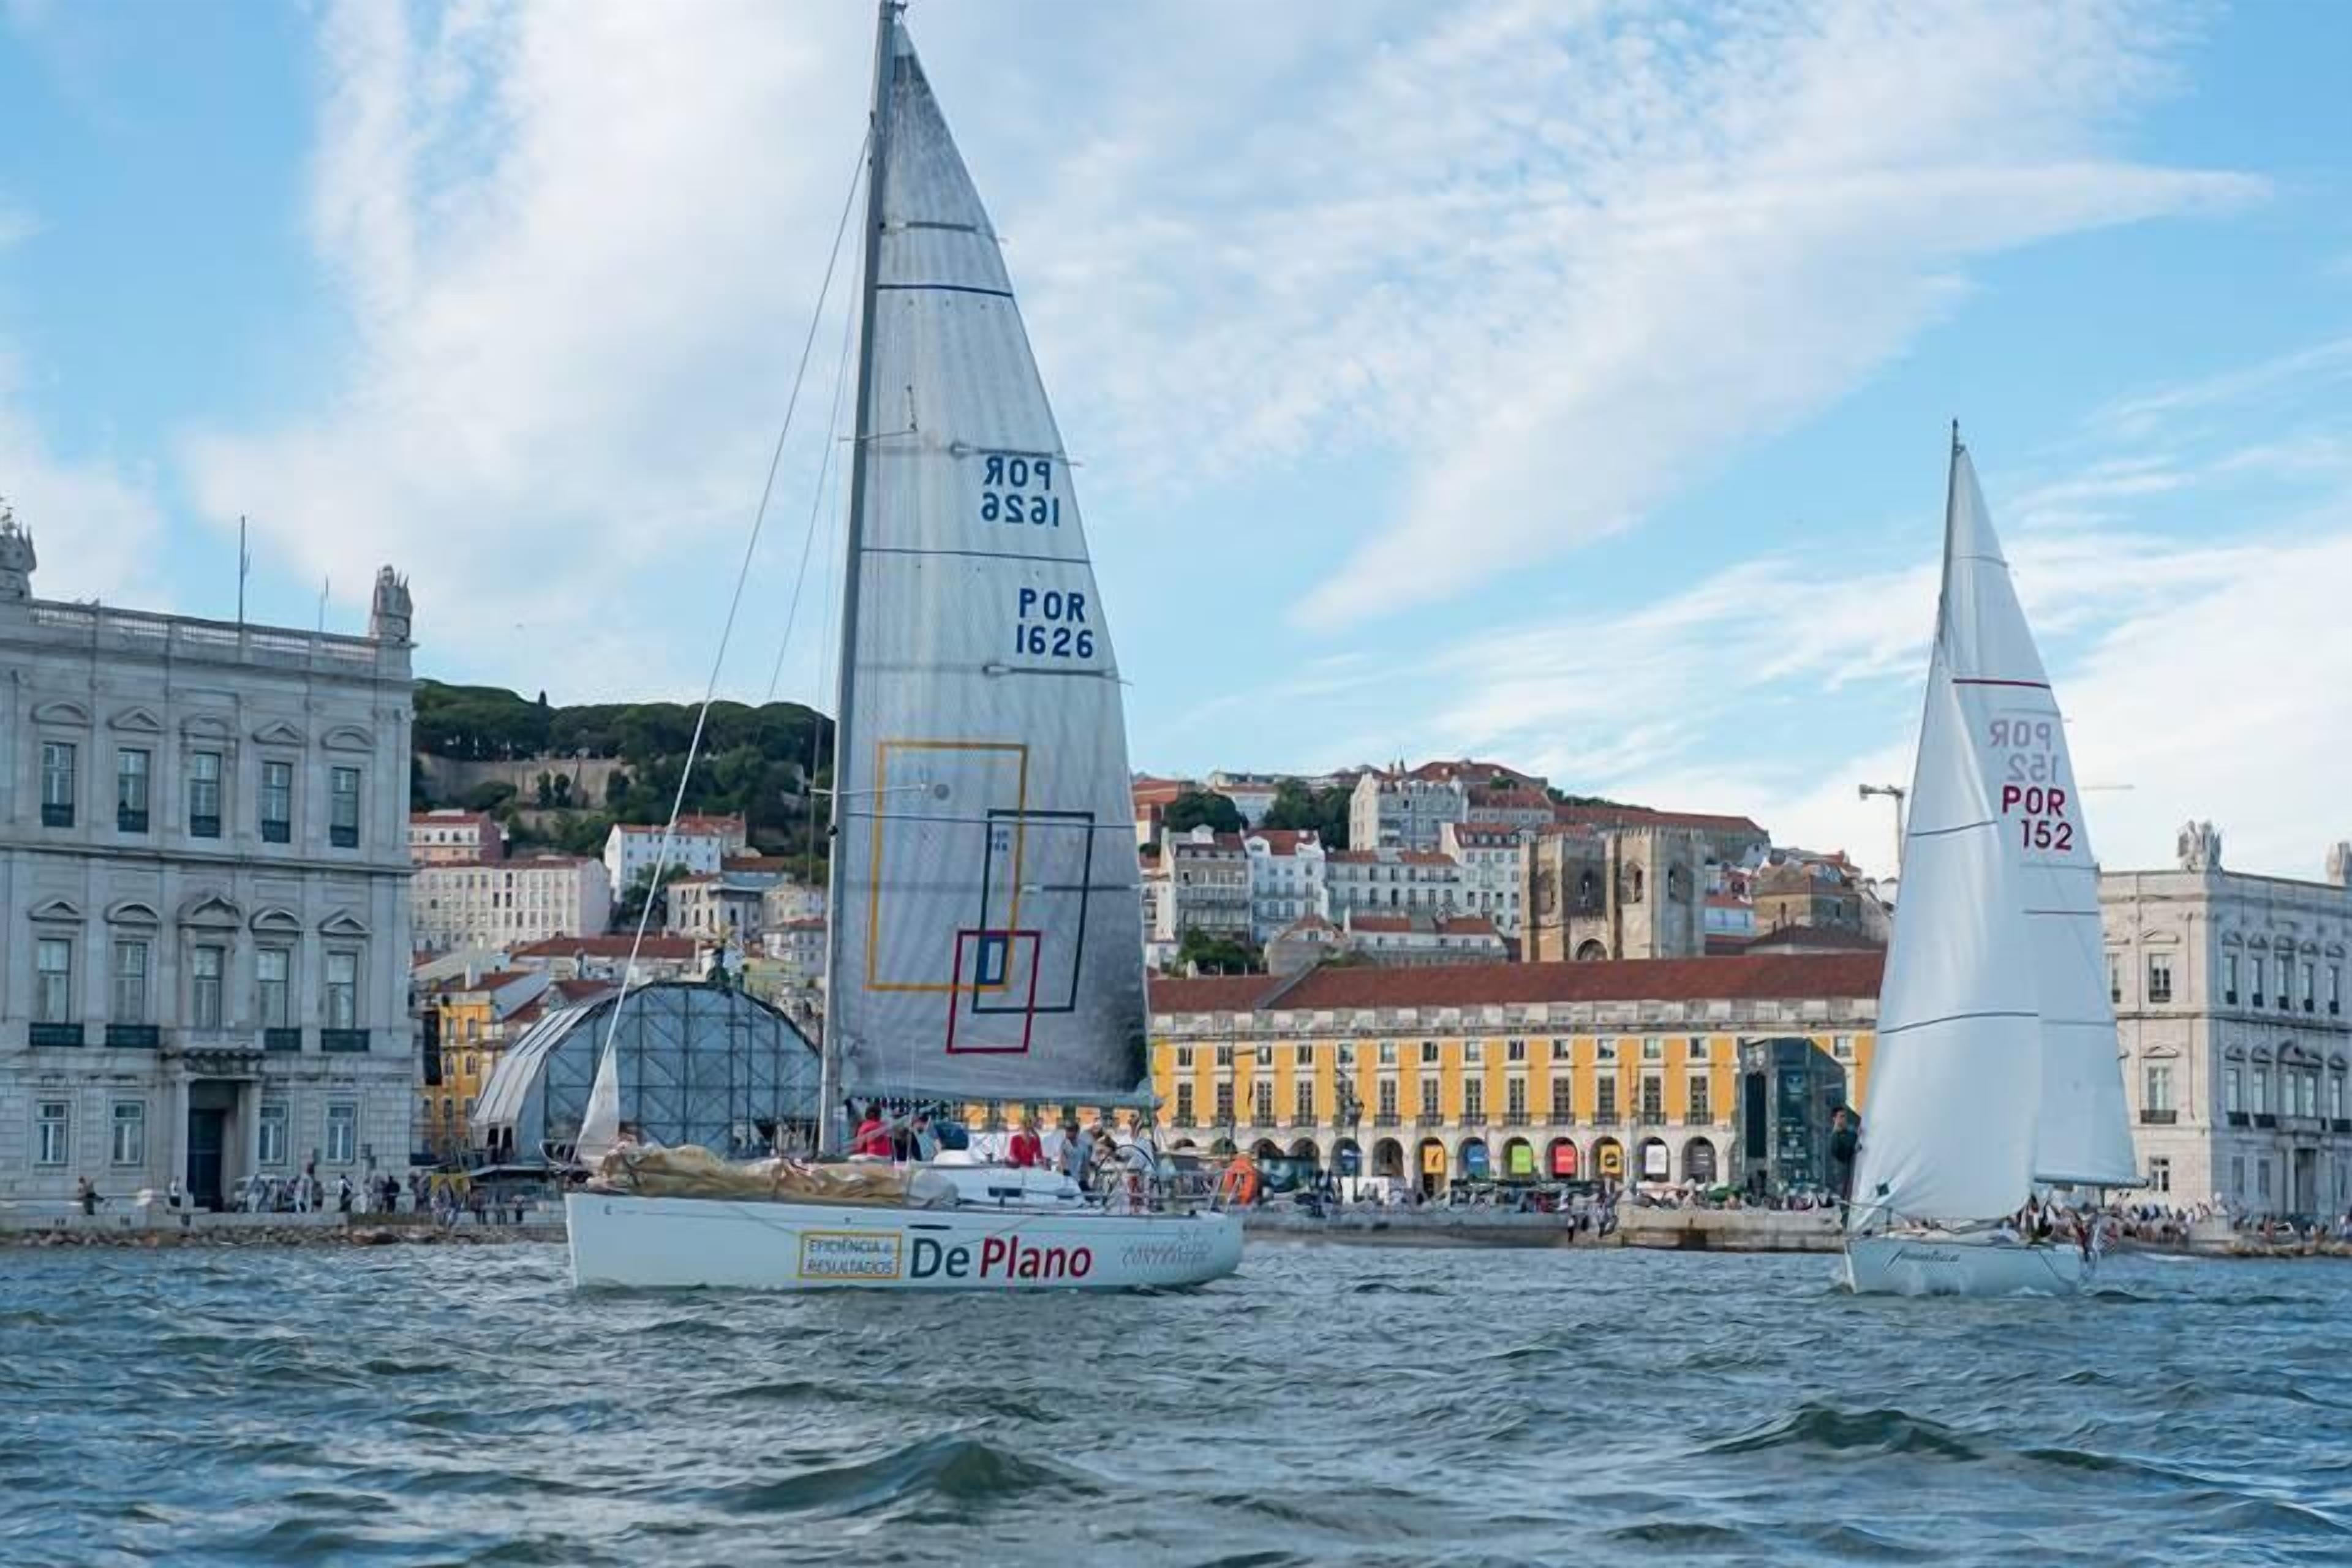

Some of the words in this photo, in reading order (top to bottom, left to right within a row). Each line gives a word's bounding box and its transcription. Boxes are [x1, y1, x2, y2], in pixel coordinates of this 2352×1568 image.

[1019, 587, 1085, 623] POR
[1016, 624, 1093, 658] 1626
[2002, 785, 2065, 817] POR
[2021, 819, 2073, 851] 152
[910, 1237, 970, 1279] De
[979, 1235, 1091, 1279] Plano
